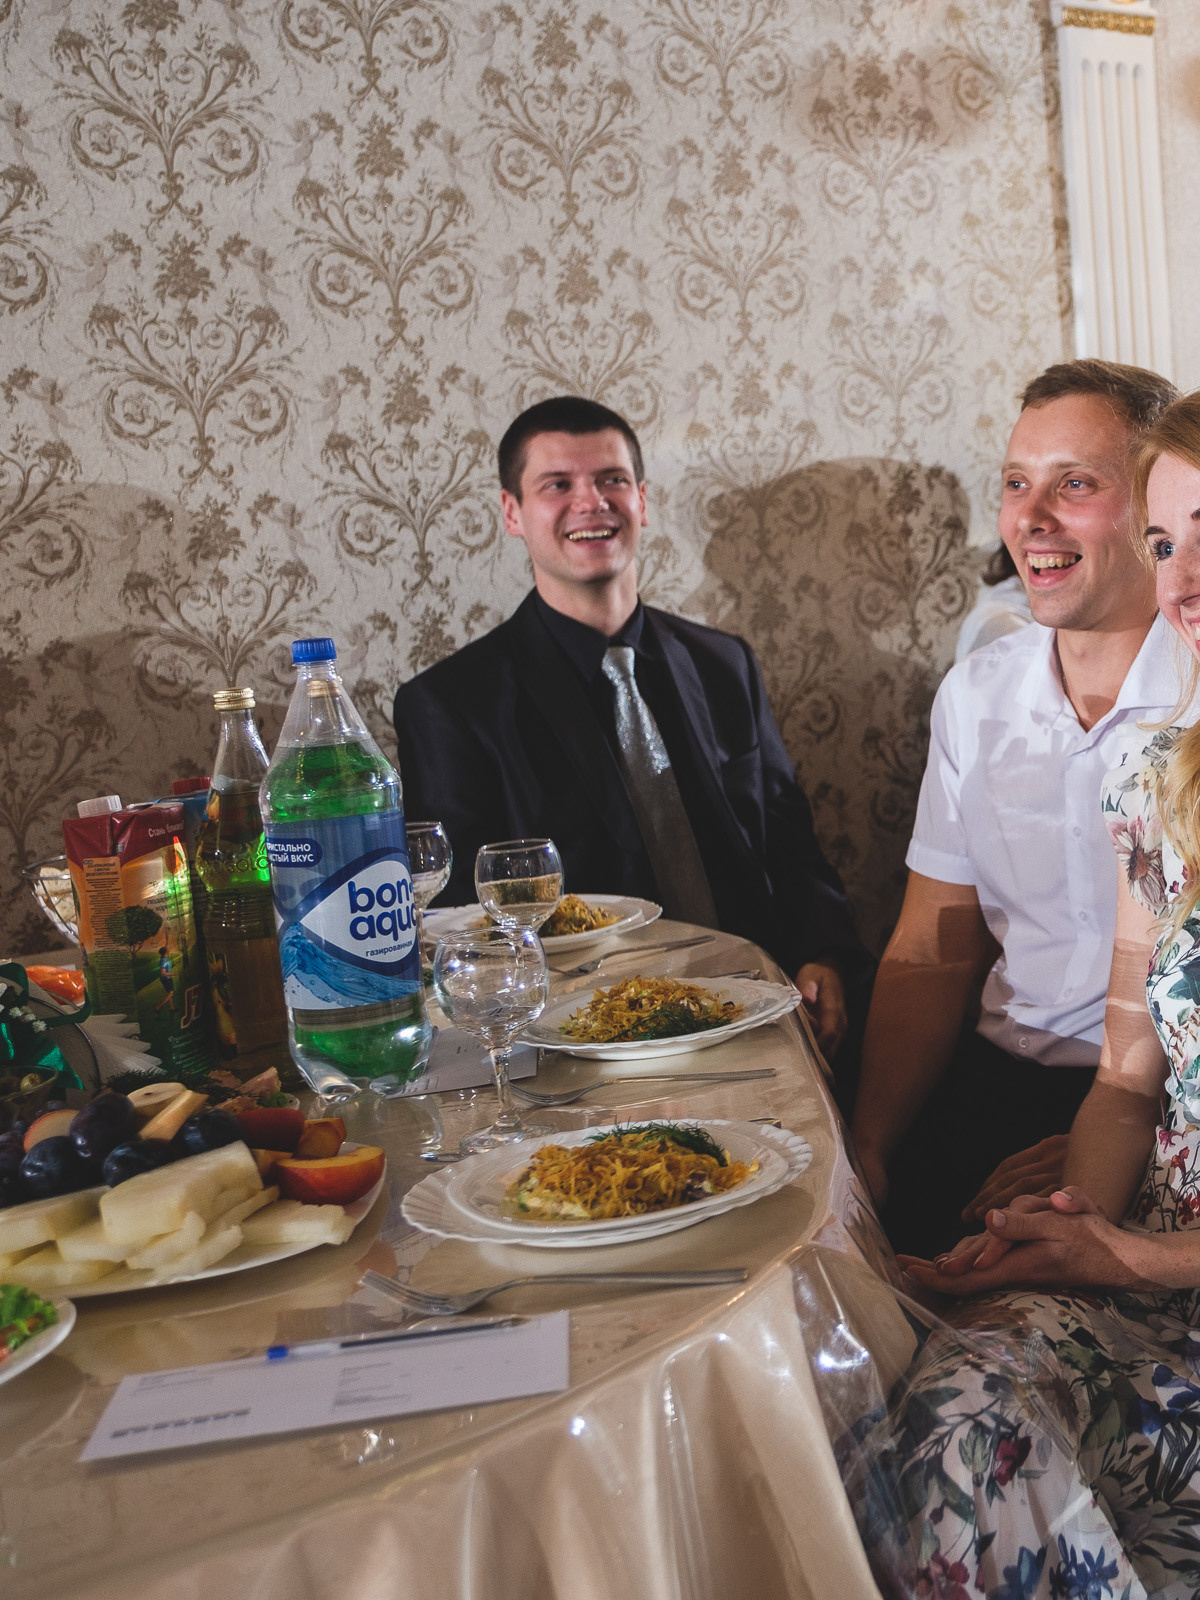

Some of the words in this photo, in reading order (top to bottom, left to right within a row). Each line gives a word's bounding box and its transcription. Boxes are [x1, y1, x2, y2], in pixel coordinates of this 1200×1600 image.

[268, 852, 289, 862] ИСТЫЙ
[290, 854, 314, 862] ВКУС
[348, 878, 410, 914] bon
